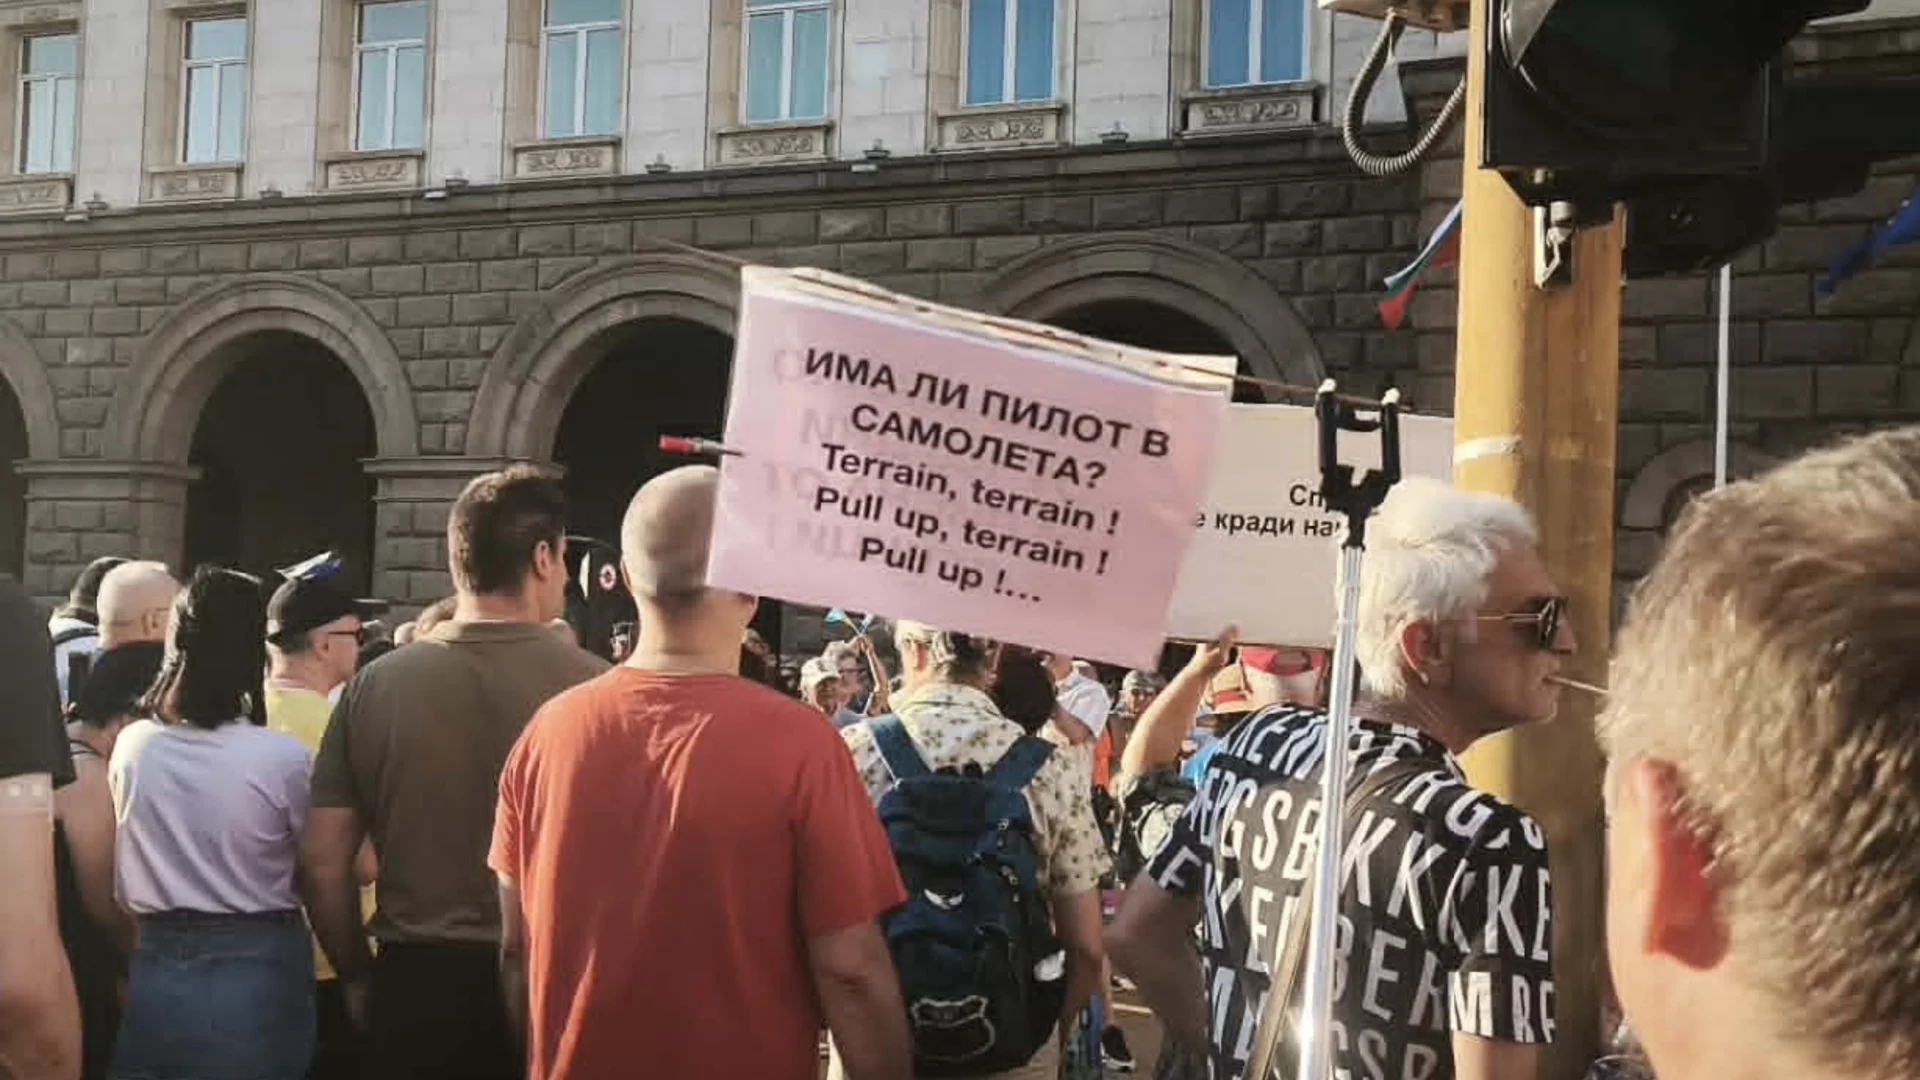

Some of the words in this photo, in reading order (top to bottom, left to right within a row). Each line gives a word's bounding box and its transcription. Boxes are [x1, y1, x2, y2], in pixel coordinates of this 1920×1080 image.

[805, 348, 897, 395] ИМА
[907, 372, 970, 410] ЛИ
[980, 389, 1133, 449] ПИЛОТ
[1140, 428, 1171, 458] В
[821, 442, 957, 502] Terrain,
[971, 478, 1096, 532] terrain
[851, 403, 1107, 490] САМОЛЕТА?
[814, 486, 884, 522] Pull
[894, 507, 948, 543] up,
[963, 519, 1085, 572] terrain
[1215, 513, 1295, 537] кради
[1289, 484, 1330, 513] Сп
[859, 536, 928, 574] Pull
[937, 560, 984, 592] up
